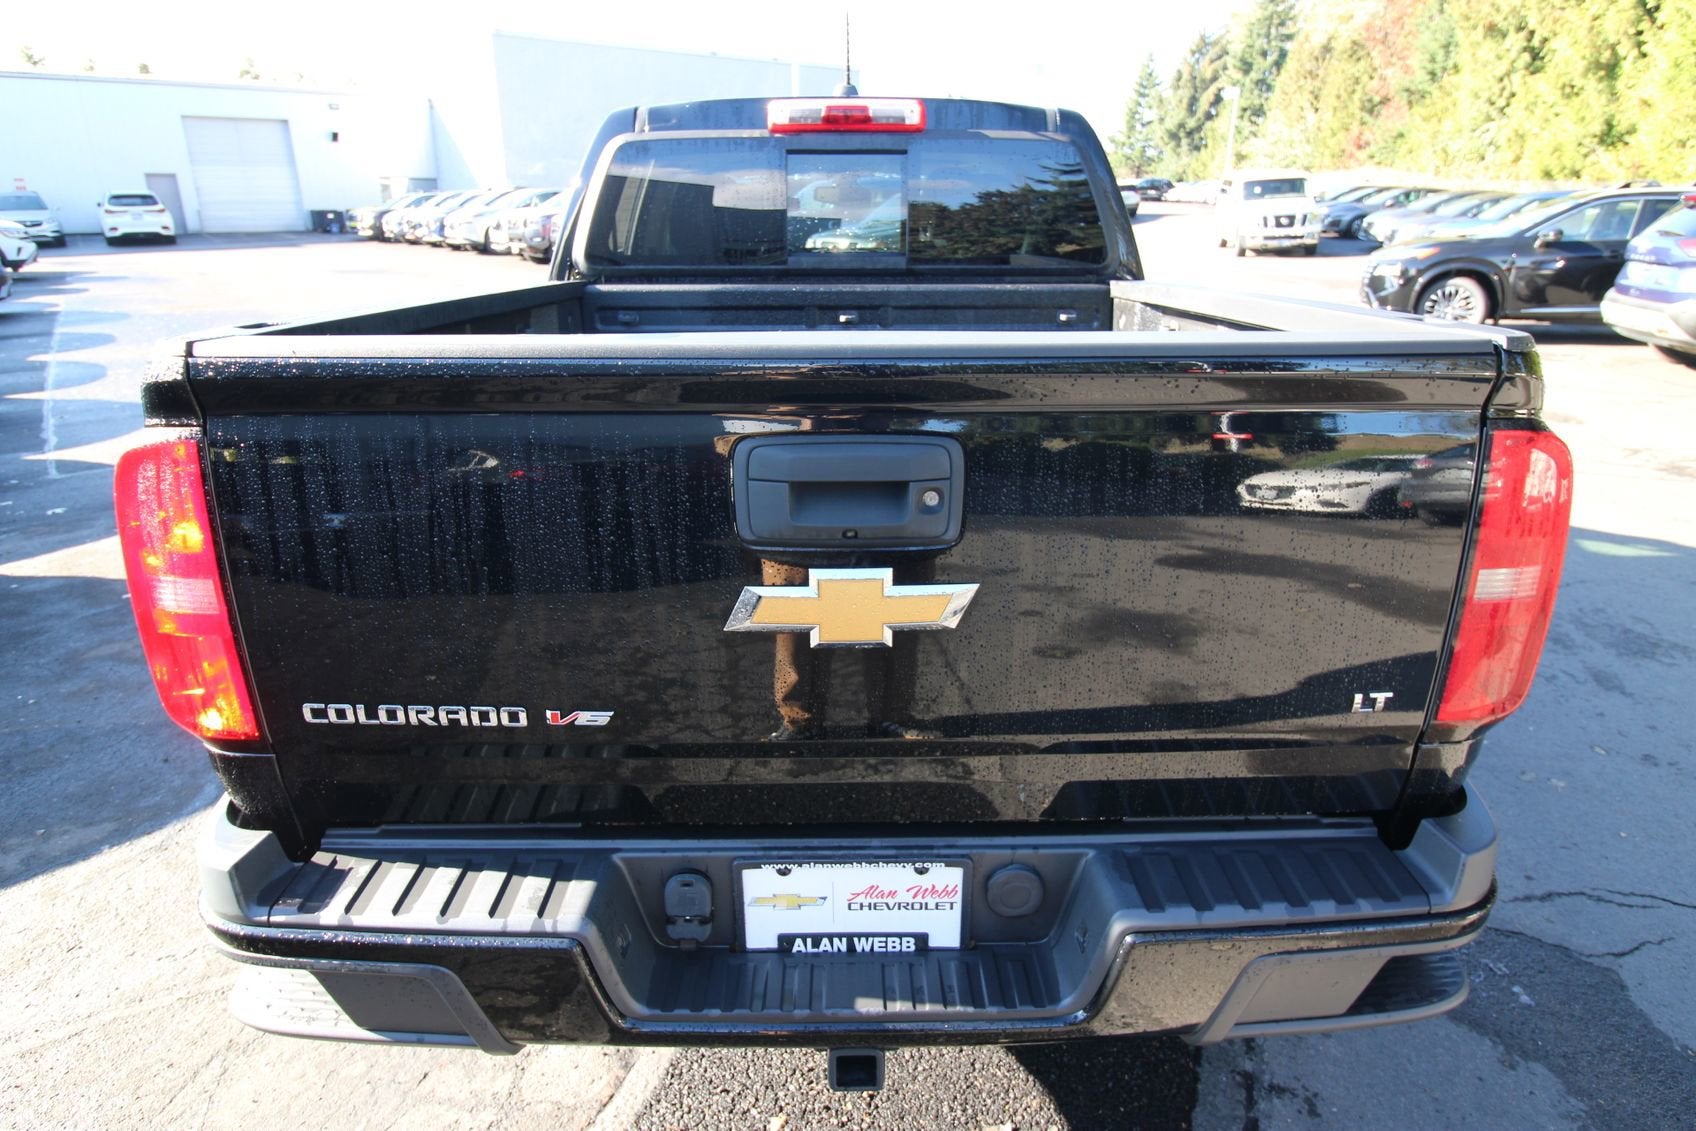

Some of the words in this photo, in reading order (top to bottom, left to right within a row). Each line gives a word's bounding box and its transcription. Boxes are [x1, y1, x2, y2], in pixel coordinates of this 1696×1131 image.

[1351, 692, 1394, 713] LT
[302, 703, 528, 727] COLORADO
[545, 708, 615, 726] V6
[847, 884, 898, 902] Alan
[906, 883, 959, 900] Webb
[847, 901, 958, 911] CHEVROLET
[791, 937, 848, 953] ALAN
[853, 937, 916, 953] WEBB
